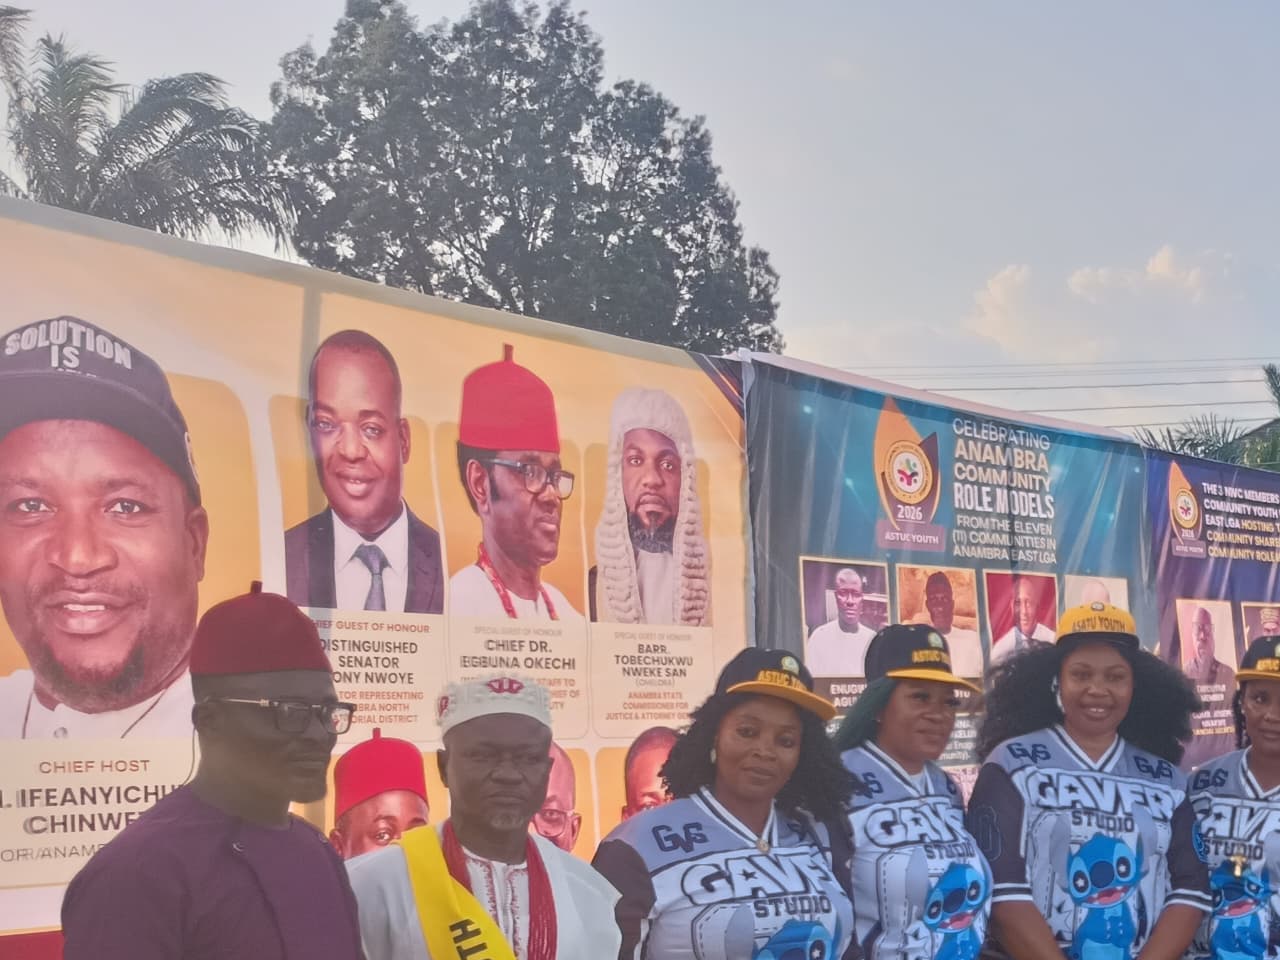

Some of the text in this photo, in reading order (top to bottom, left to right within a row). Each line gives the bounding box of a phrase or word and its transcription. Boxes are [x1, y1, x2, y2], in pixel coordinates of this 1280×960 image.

[5, 319, 134, 370] SOLUTION
[50, 345, 80, 369] IS
[952, 417, 1051, 451] CELEBRATING
[954, 438, 1049, 473] ANAMBRA
[954, 461, 1052, 493] COMMUNITY
[953, 482, 1055, 519] ROLE MODELS
[1201, 481, 1218, 495] THE
[1217, 485, 1224, 497] 3
[1243, 489, 1280, 504] MEMBERS
[896, 504, 923, 521] 2026
[1203, 498, 1253, 515] COMMUNITY
[1252, 506, 1278, 519] YOUTH
[956, 514, 1052, 536] FROM THE ELEVEN
[1205, 514, 1225, 527] EAST
[1224, 517, 1241, 529] LGA
[1241, 519, 1275, 533] HOSTING
[911, 533, 939, 545] YOUTH
[969, 530, 1046, 550] COMMUNITIES
[1046, 538, 1057, 551] IN
[1206, 530, 1254, 545] COMMUNITY
[953, 545, 1057, 564] ANAMBRA EAST LGA
[1208, 545, 1256, 561] COMMUNITY
[1256, 550, 1274, 562] ROLE
[335, 620, 431, 633] GUEST OF HONOUR
[1097, 615, 1127, 633] YOUTH
[320, 638, 419, 654] DISTINGUISHED
[485, 639, 553, 653] CHIEF DR.
[338, 655, 400, 669] SENATOR
[460, 655, 576, 670] EGBUNA OKECHI
[613, 654, 694, 666] TOBECHUKWU
[332, 671, 414, 685] ONY NWOYE
[621, 666, 688, 678] NWEKE SAN
[359, 691, 424, 701] REPRESENTING
[378, 703, 410, 713] NORTH
[378, 714, 419, 724] DISTRICT
[38, 759, 151, 775] CHIEF HOST
[1026, 768, 1175, 824] GAVER
[1071, 810, 1135, 832] STUDIO
[924, 842, 977, 860] STUDIO
[1203, 838, 1264, 861] STUDIO
[680, 850, 832, 907] GAVE
[753, 895, 832, 918] STUDIO
